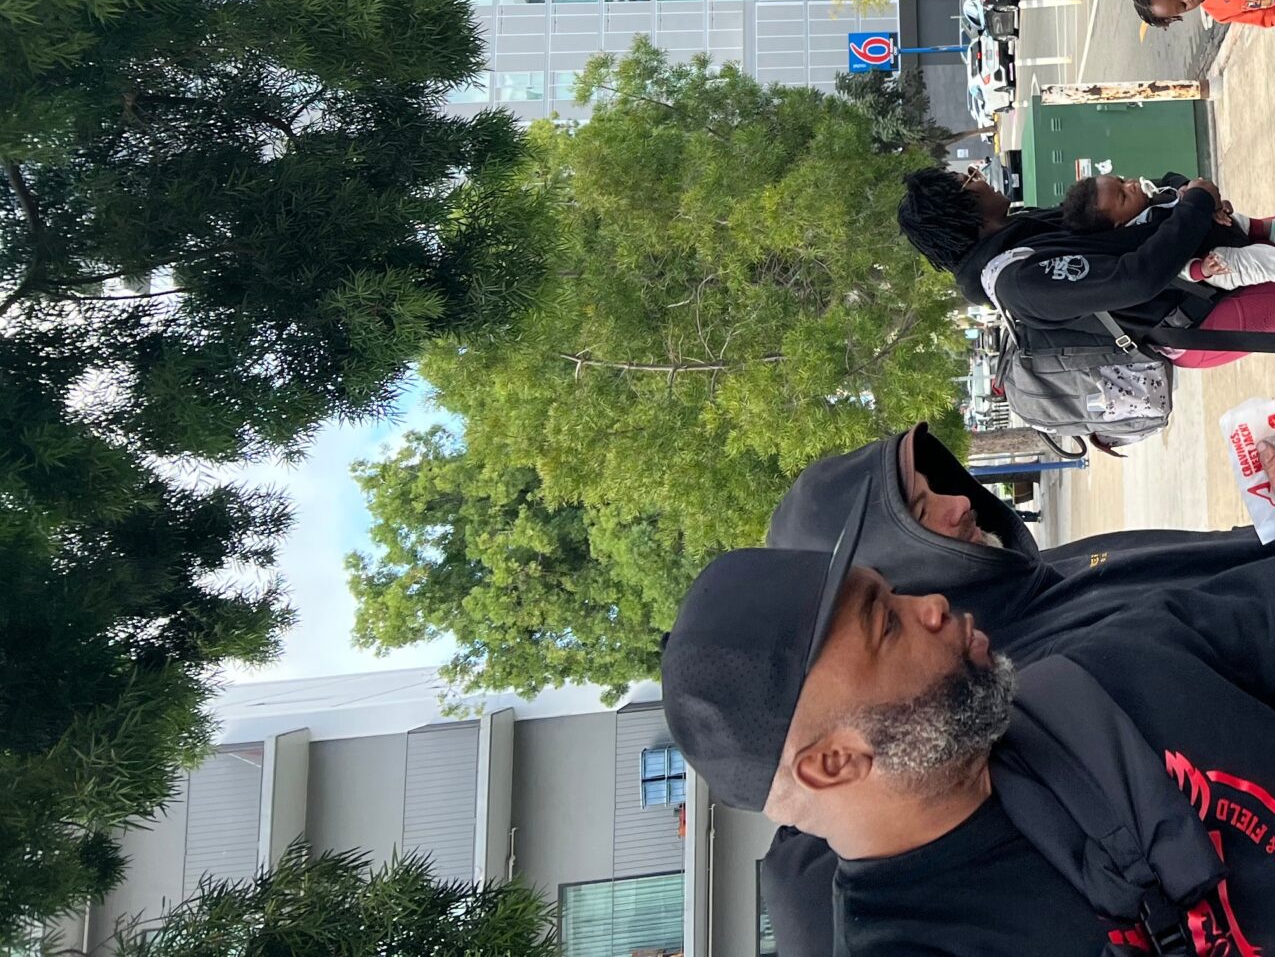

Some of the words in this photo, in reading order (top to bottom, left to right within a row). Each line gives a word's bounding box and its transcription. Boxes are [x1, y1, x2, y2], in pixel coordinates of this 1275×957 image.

[850, 37, 891, 64] 6
[1238, 423, 1255, 446] JACK!
[1248, 448, 1263, 473] MEET
[1216, 798, 1268, 844] FIELD
